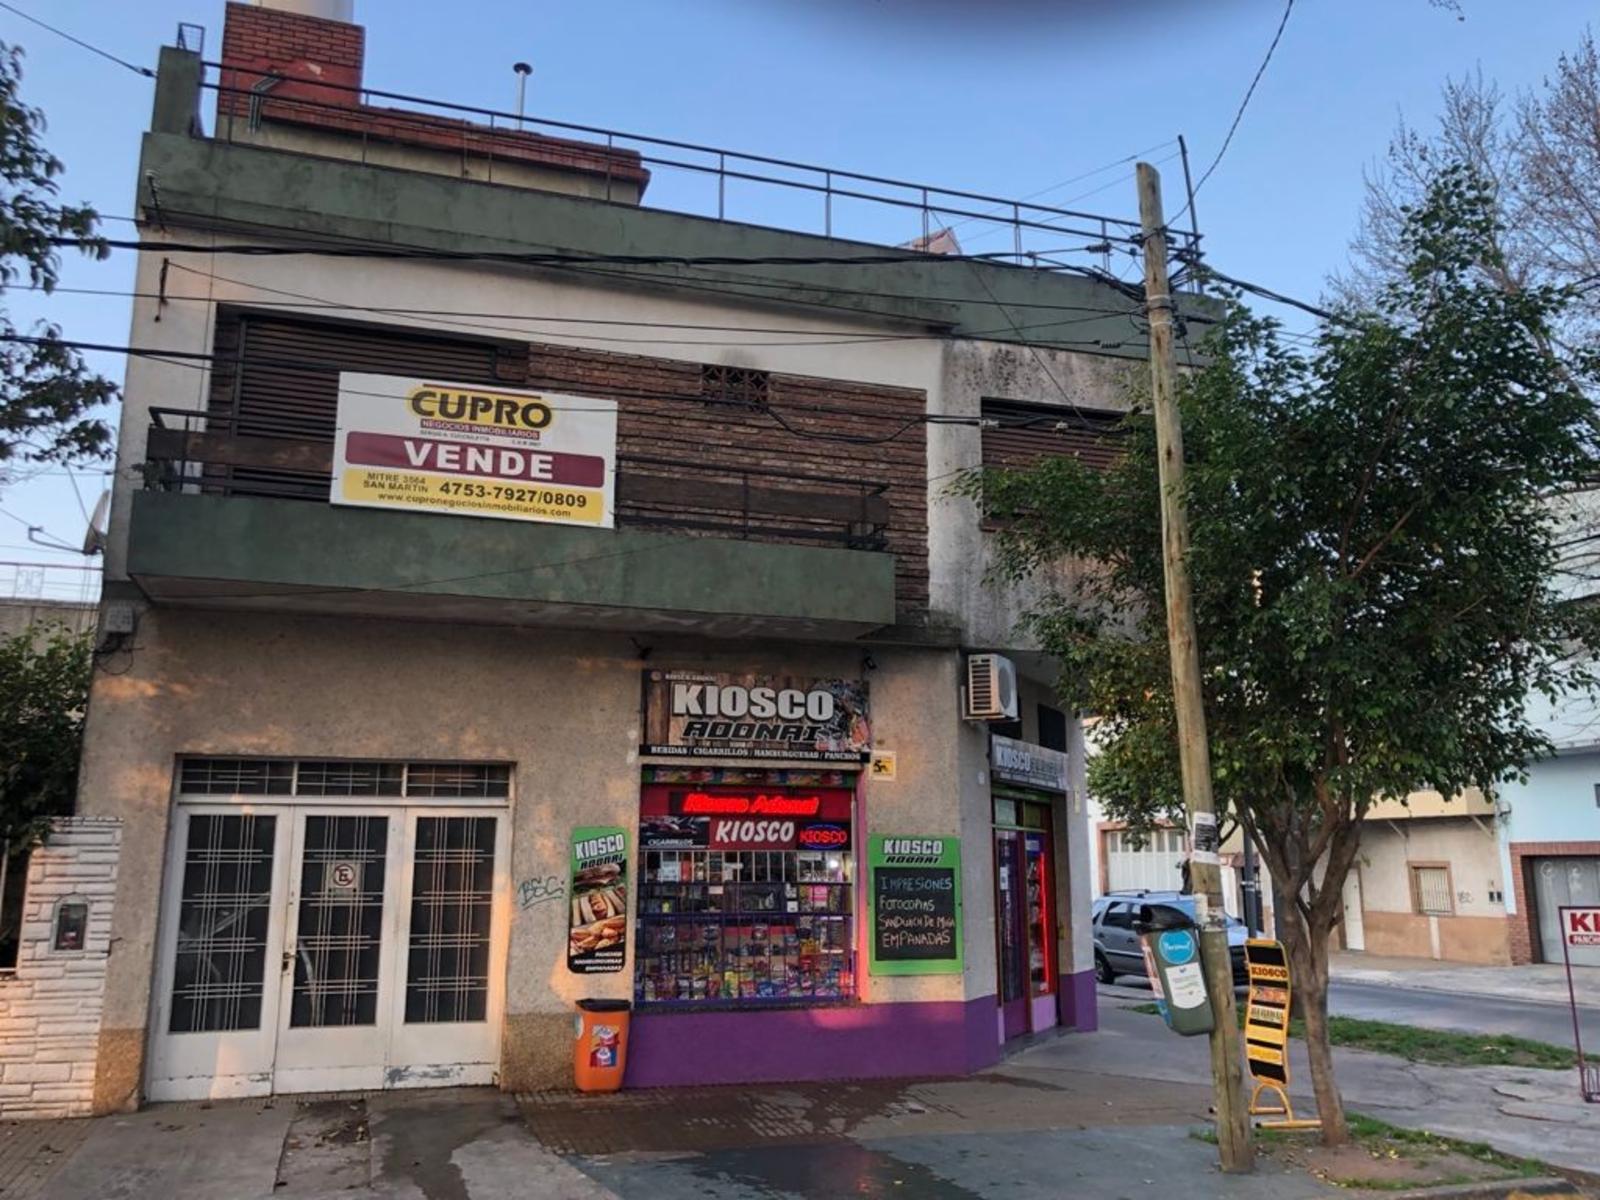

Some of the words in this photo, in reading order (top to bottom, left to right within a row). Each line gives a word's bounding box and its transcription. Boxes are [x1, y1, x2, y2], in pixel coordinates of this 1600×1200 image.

[411, 389, 552, 429] CUPRO
[422, 420, 470, 432] NEGOCIOS
[471, 425, 540, 439] INMOBILIARIOS
[403, 440, 554, 479] VENDE
[363, 480, 385, 489] SAN
[388, 481, 428, 493] MARTIN
[367, 472, 400, 482] MITRE
[439, 482, 588, 508] 4753-7927/0809
[673, 683, 834, 721] KIOSCO
[682, 721, 820, 742] ADONAI
[996, 745, 1031, 771] KIOSCO
[715, 820, 796, 844] KIOSCO
[800, 830, 848, 844] KIOSCO
[575, 833, 625, 860] KIOSCO
[883, 839, 943, 854] KIOSCO
[882, 929, 951, 949] EMPANADAS
[1251, 965, 1288, 978] KIOSCO
